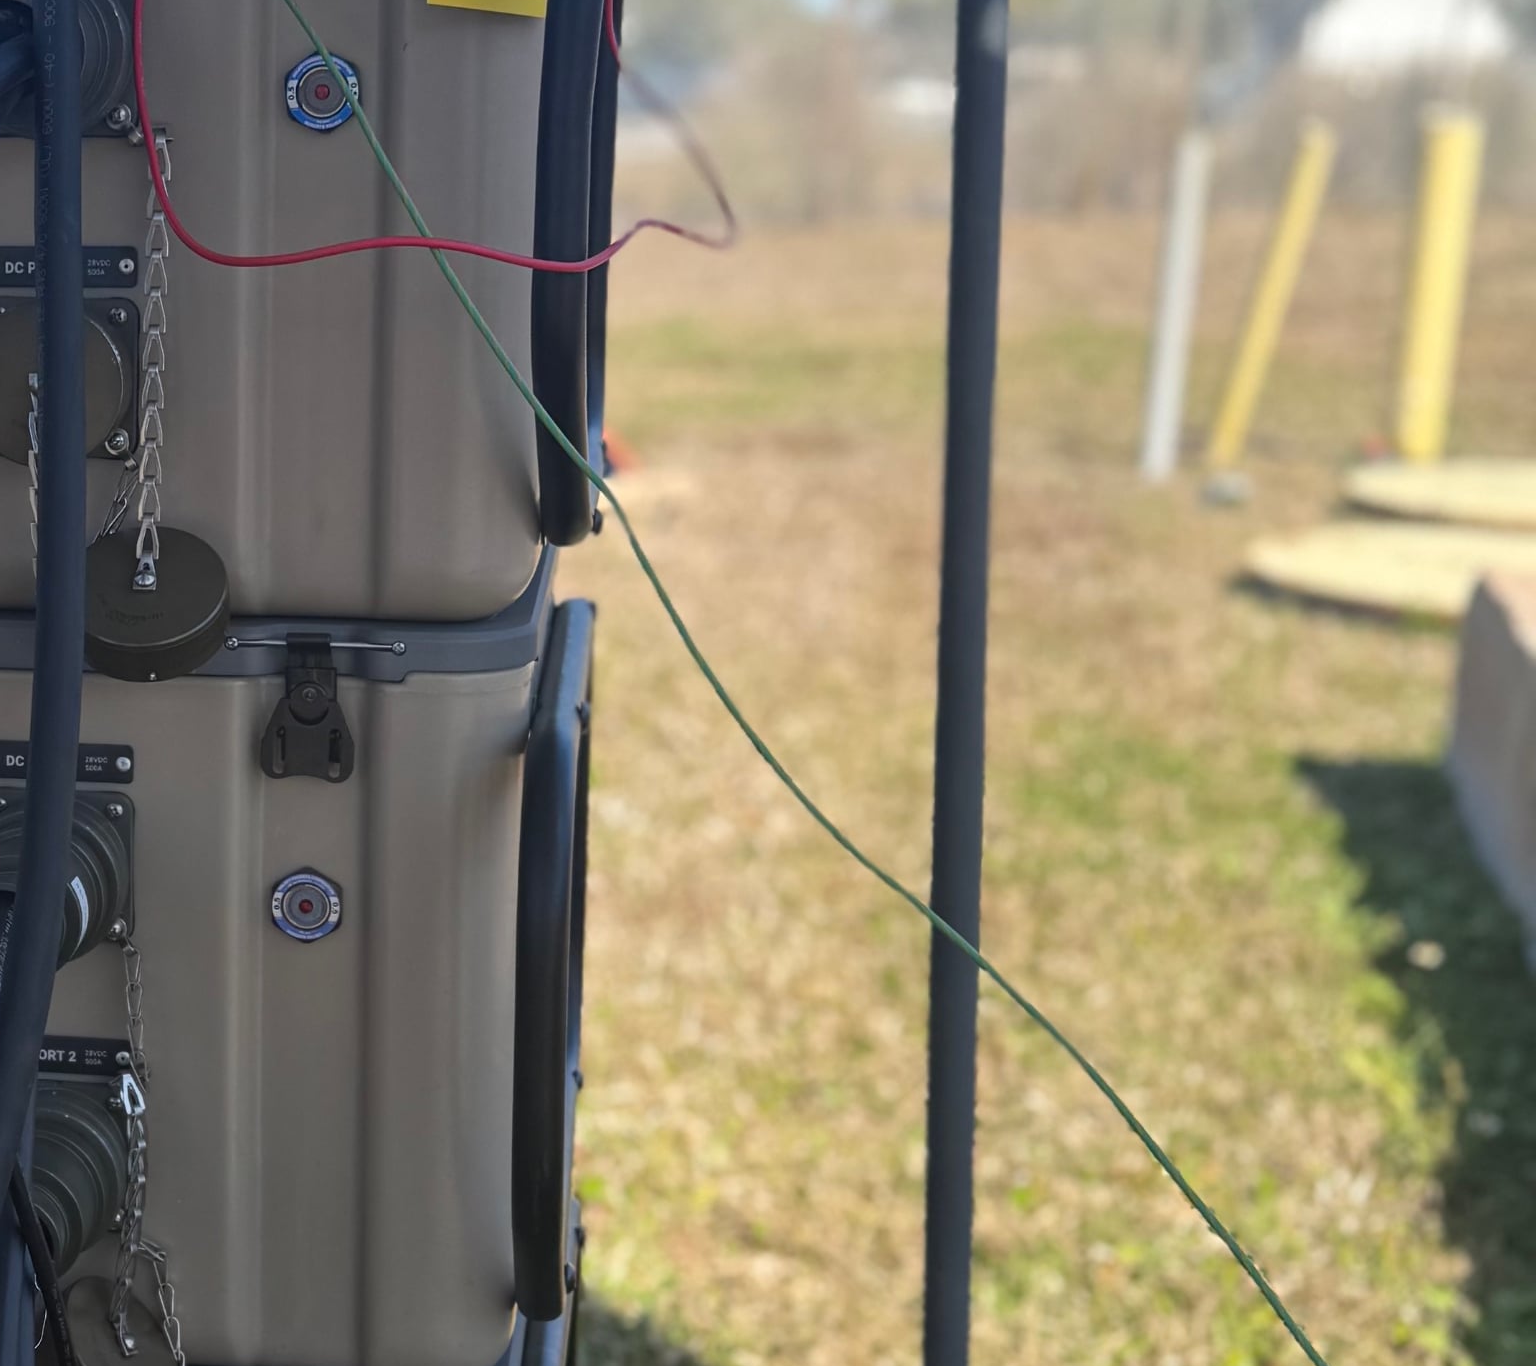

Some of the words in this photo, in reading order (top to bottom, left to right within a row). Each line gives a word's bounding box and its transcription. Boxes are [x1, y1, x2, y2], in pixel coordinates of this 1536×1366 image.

[5, 261, 25, 274] DC
[6, 755, 25, 767] DC
[39, 1049, 65, 1063] ORT
[68, 1051, 77, 1063] 2
